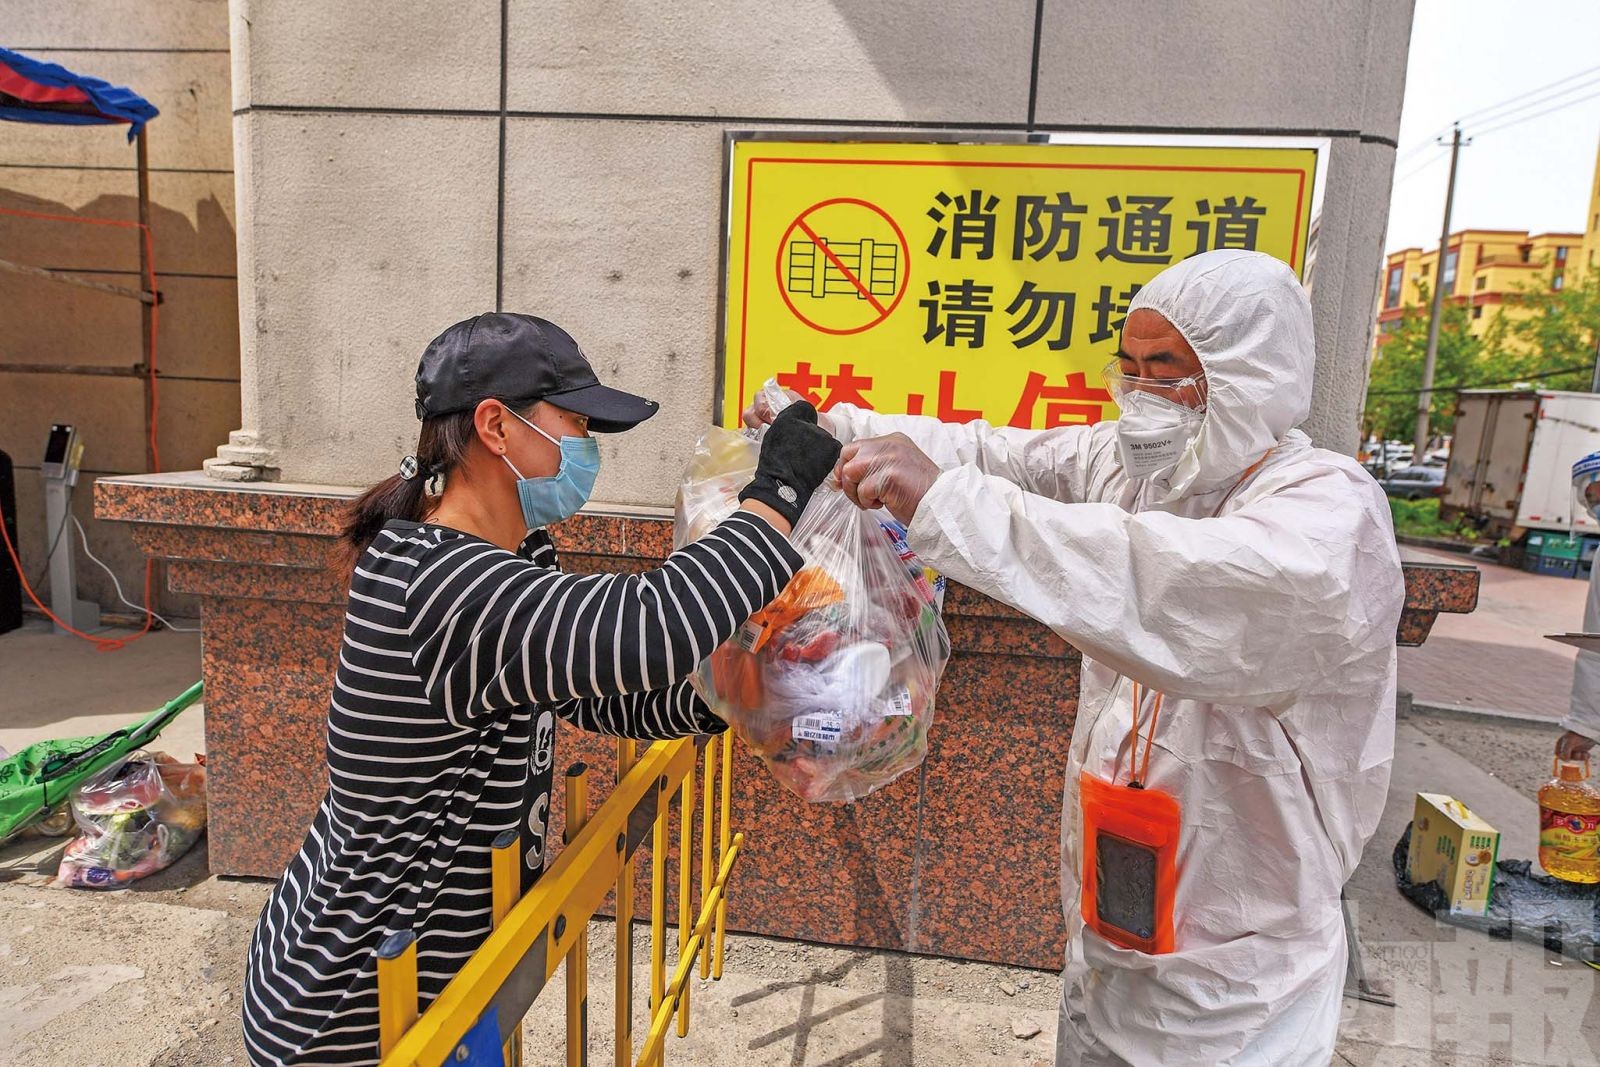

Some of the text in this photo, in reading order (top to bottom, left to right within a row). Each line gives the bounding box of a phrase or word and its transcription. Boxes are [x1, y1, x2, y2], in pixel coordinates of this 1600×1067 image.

[926, 190, 1266, 265] 消防通道
[1130, 439, 1172, 450] 3M 9502V+
